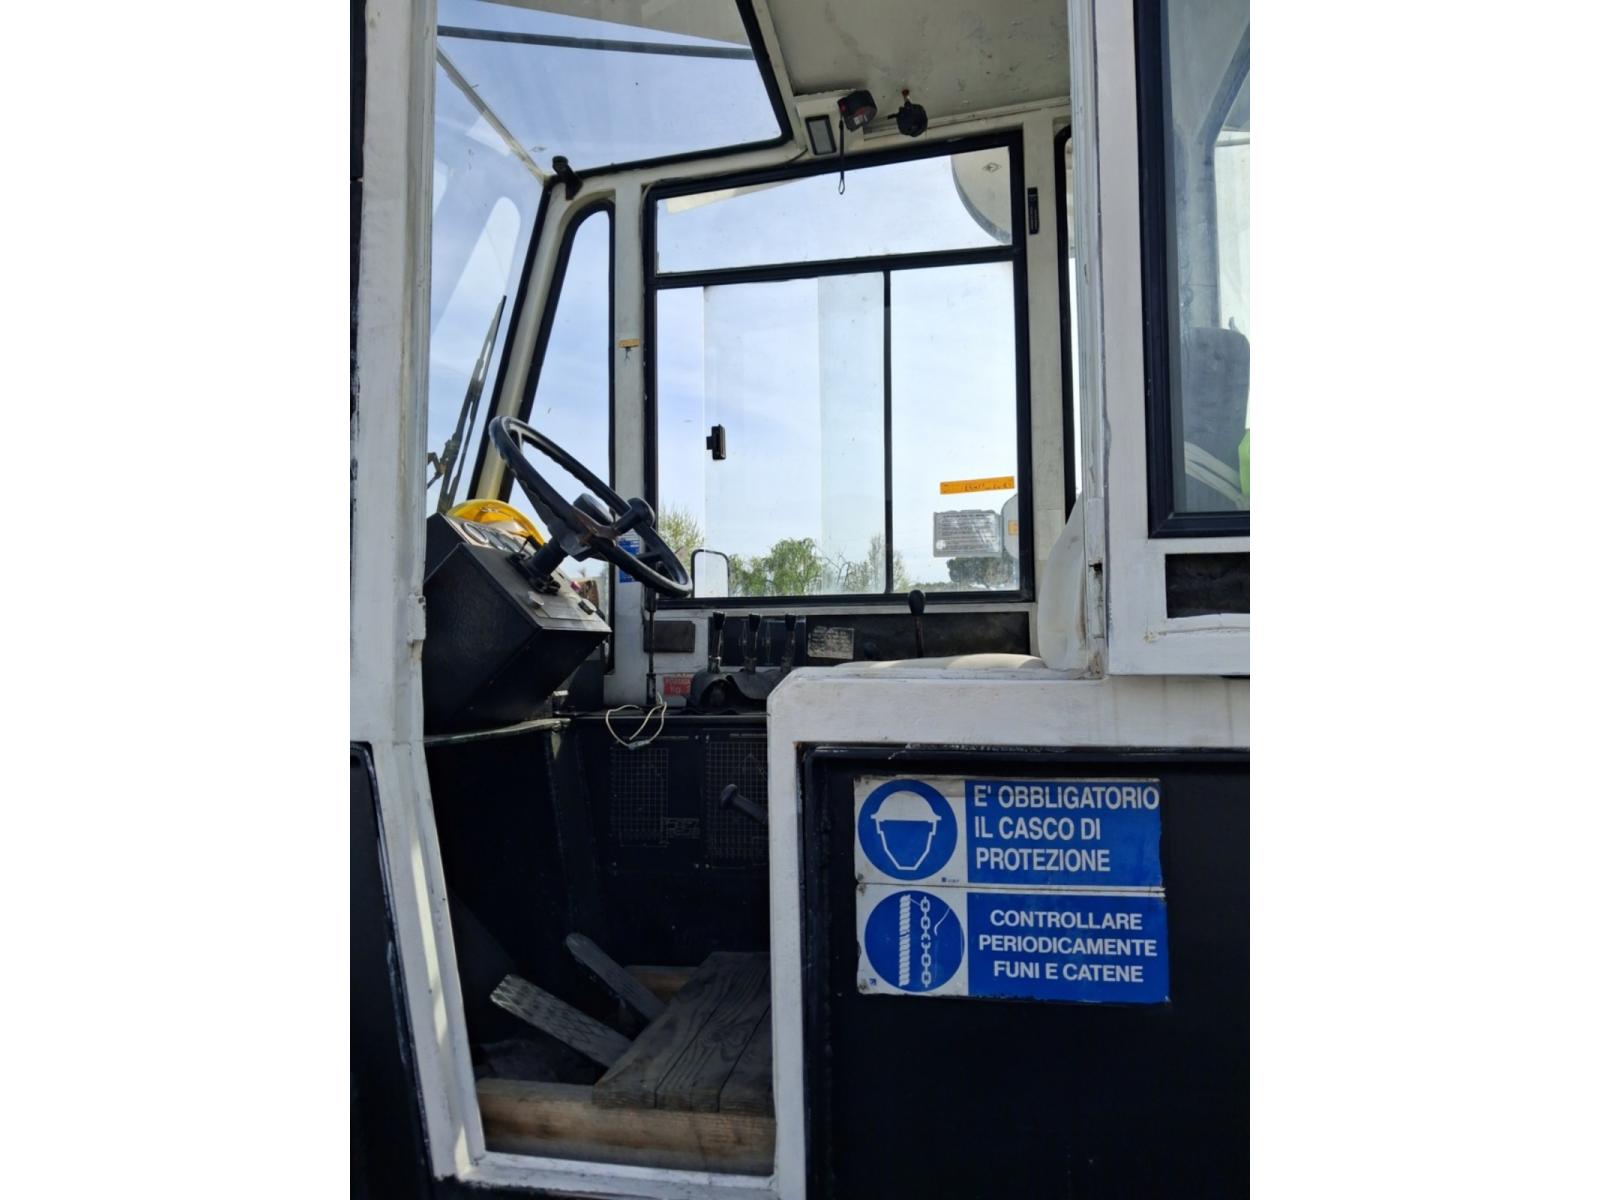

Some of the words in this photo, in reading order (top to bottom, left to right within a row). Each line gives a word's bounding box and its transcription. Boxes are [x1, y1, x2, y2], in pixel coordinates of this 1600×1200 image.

[974, 785, 991, 807] E'
[998, 785, 1160, 810] OBBLIGATORIO
[975, 816, 993, 838] IL
[998, 816, 1074, 840] CASCO
[1081, 818, 1101, 840] DI
[976, 847, 1111, 872] PROTEZIONE
[990, 909, 1142, 930] CONTROLLARE
[979, 934, 1157, 956] PERIODICAMENTE
[994, 960, 1040, 978] FUNI
[1045, 963, 1058, 980] E
[1062, 963, 1144, 982] CATENE
